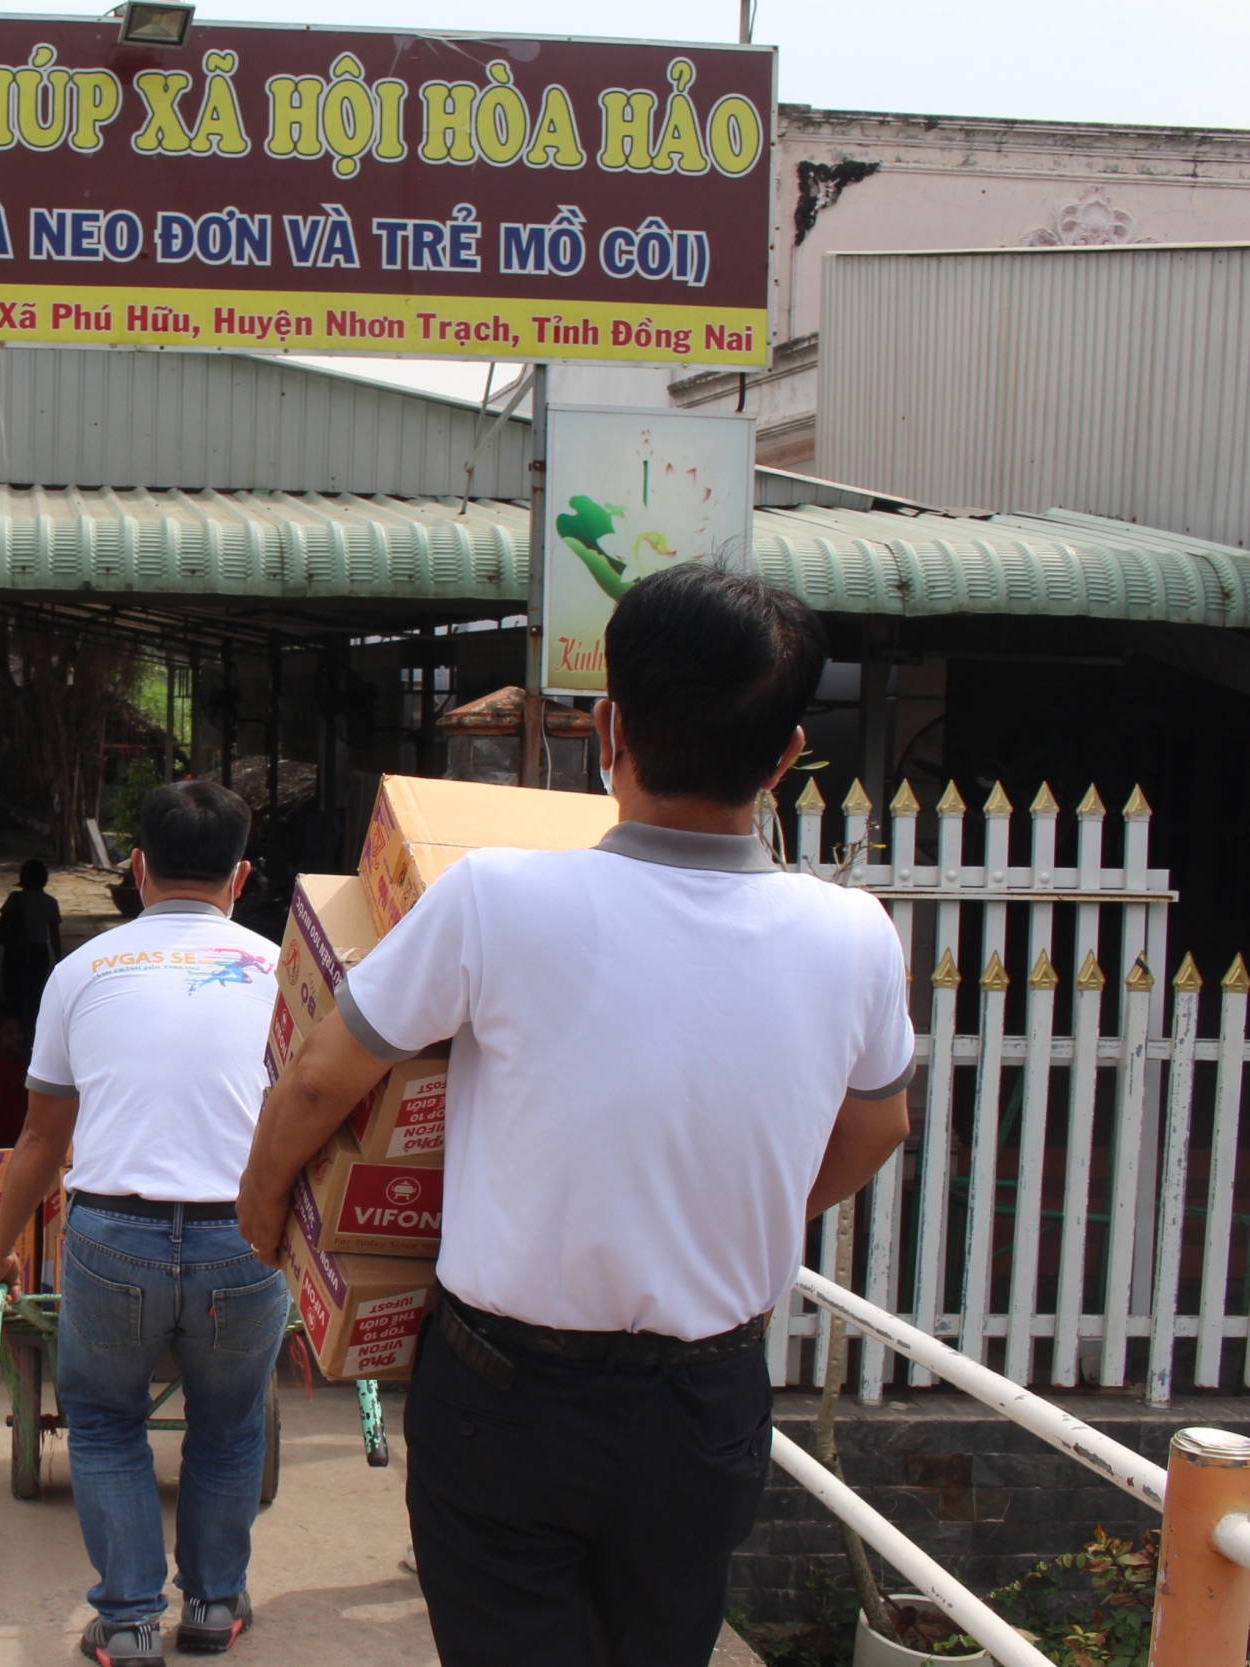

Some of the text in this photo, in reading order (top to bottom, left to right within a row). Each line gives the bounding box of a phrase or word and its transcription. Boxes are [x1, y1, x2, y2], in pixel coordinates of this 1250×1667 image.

[131, 48, 252, 158] XÃ
[264, 51, 408, 179] HỘI
[417, 59, 587, 168] HÒA
[596, 56, 763, 179] HẢO
[29, 208, 144, 263] NEO
[155, 206, 271, 267] ĐƠN
[283, 203, 360, 269] VÀ
[372, 203, 481, 273] TRẺ
[499, 204, 587, 278] MỒ
[599, 216, 709, 288] CÔI)
[51, 300, 113, 332] Phú
[126, 303, 201, 338] Hữu,
[213, 306, 312, 338] Huyện
[326, 310, 404, 339] Nhơn
[416, 311, 519, 348] Trạch,
[531, 314, 599, 346] Tỉnh
[611, 314, 692, 354] Đồng
[703, 323, 753, 352] Nai
[91, 951, 197, 973] PVGAS SE
[410, 1109, 445, 1122] OP 10
[354, 1206, 443, 1230] VIFON
[303, 1276, 325, 1326] VIFON
[359, 1311, 416, 1332] THẾ GIỚI
[363, 1325, 406, 1341] TOP 10
[358, 1339, 403, 1357] VIFON
